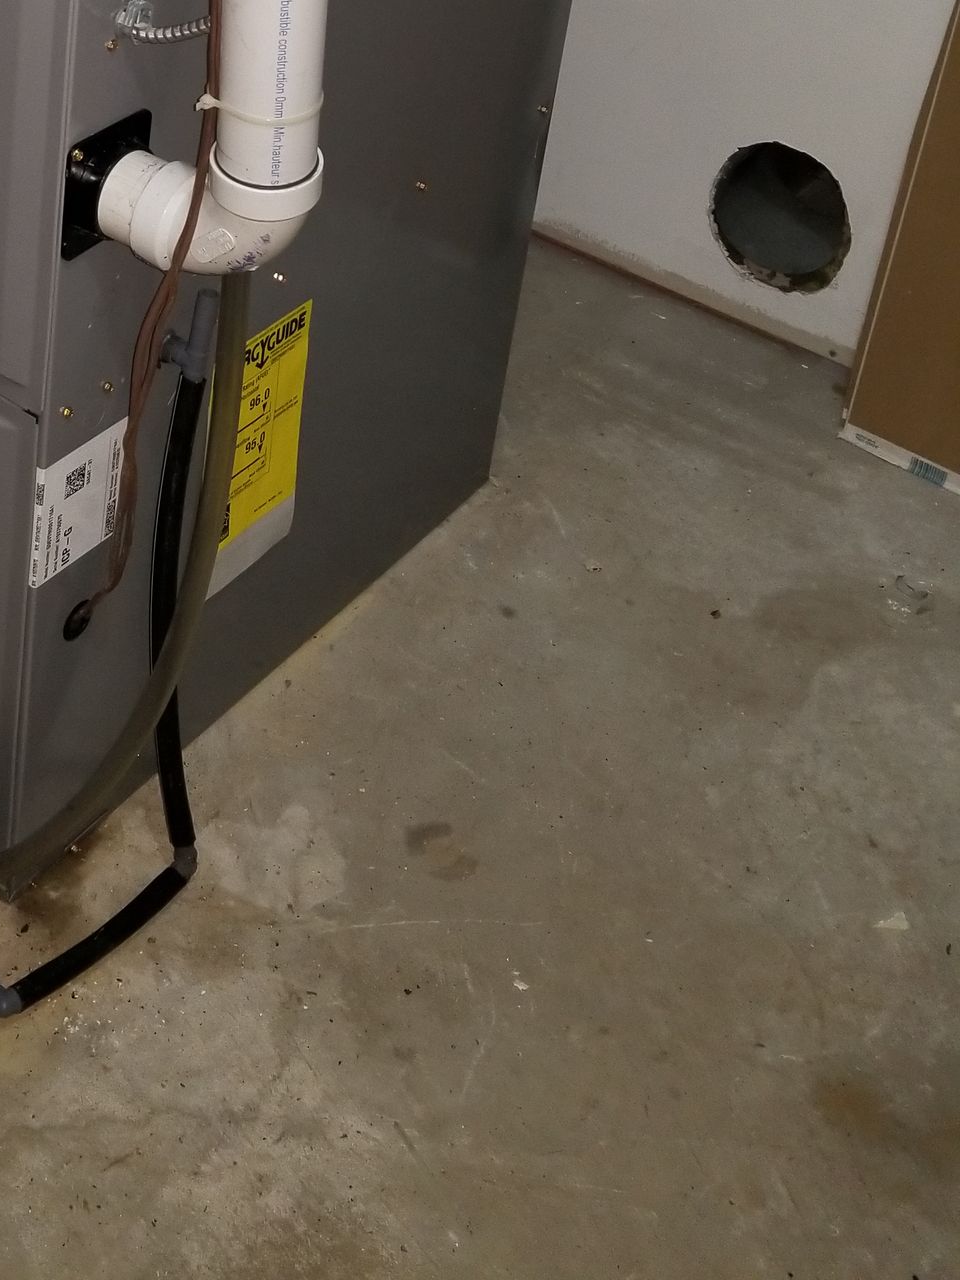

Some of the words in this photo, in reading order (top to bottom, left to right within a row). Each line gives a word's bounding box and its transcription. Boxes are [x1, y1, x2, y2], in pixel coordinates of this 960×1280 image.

[275, 39, 291, 94] construction
[274, 96, 287, 119] 0mm
[249, 387, 270, 411] 96.0
[245, 431, 266, 454] 95.0
[63, 525, 74, 537] G
[60, 547, 74, 567] ICP
